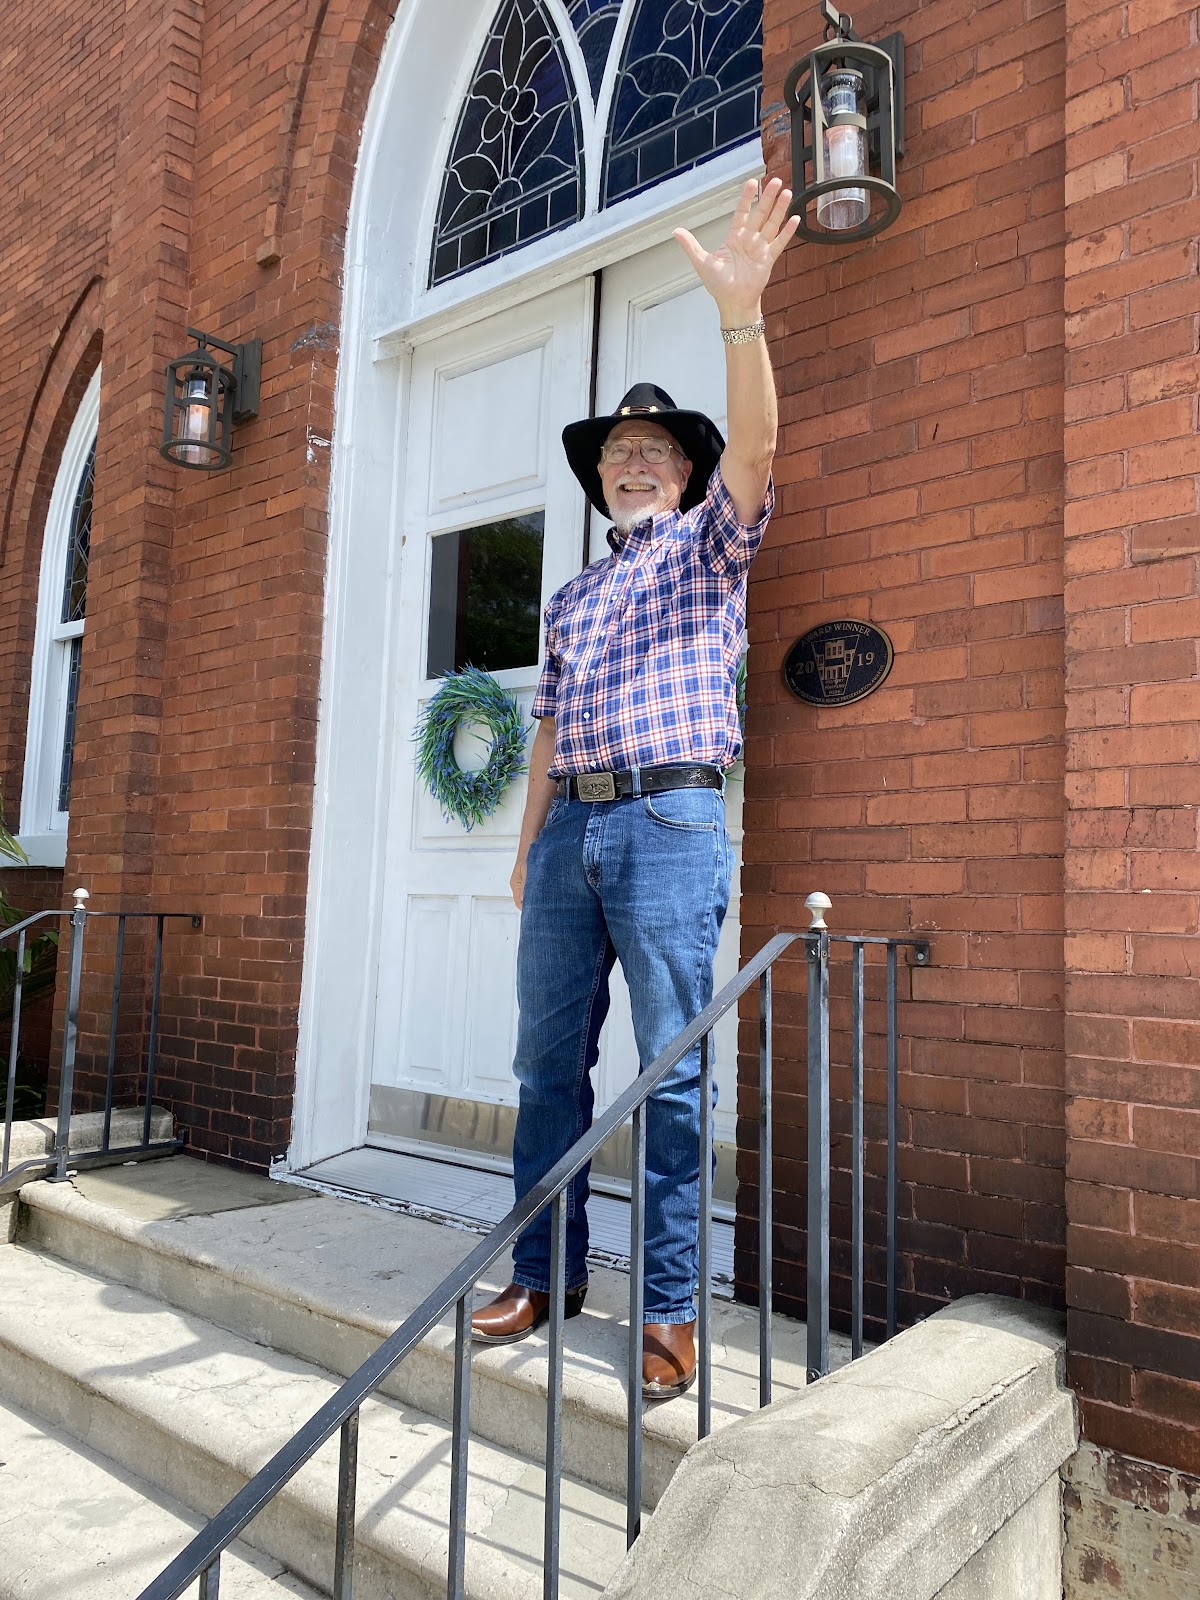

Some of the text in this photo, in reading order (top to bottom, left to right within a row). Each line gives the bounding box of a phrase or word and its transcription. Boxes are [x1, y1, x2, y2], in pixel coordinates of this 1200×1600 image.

[801, 623, 870, 646] AWARD WINNER
[795, 652, 875, 675] 20 19
